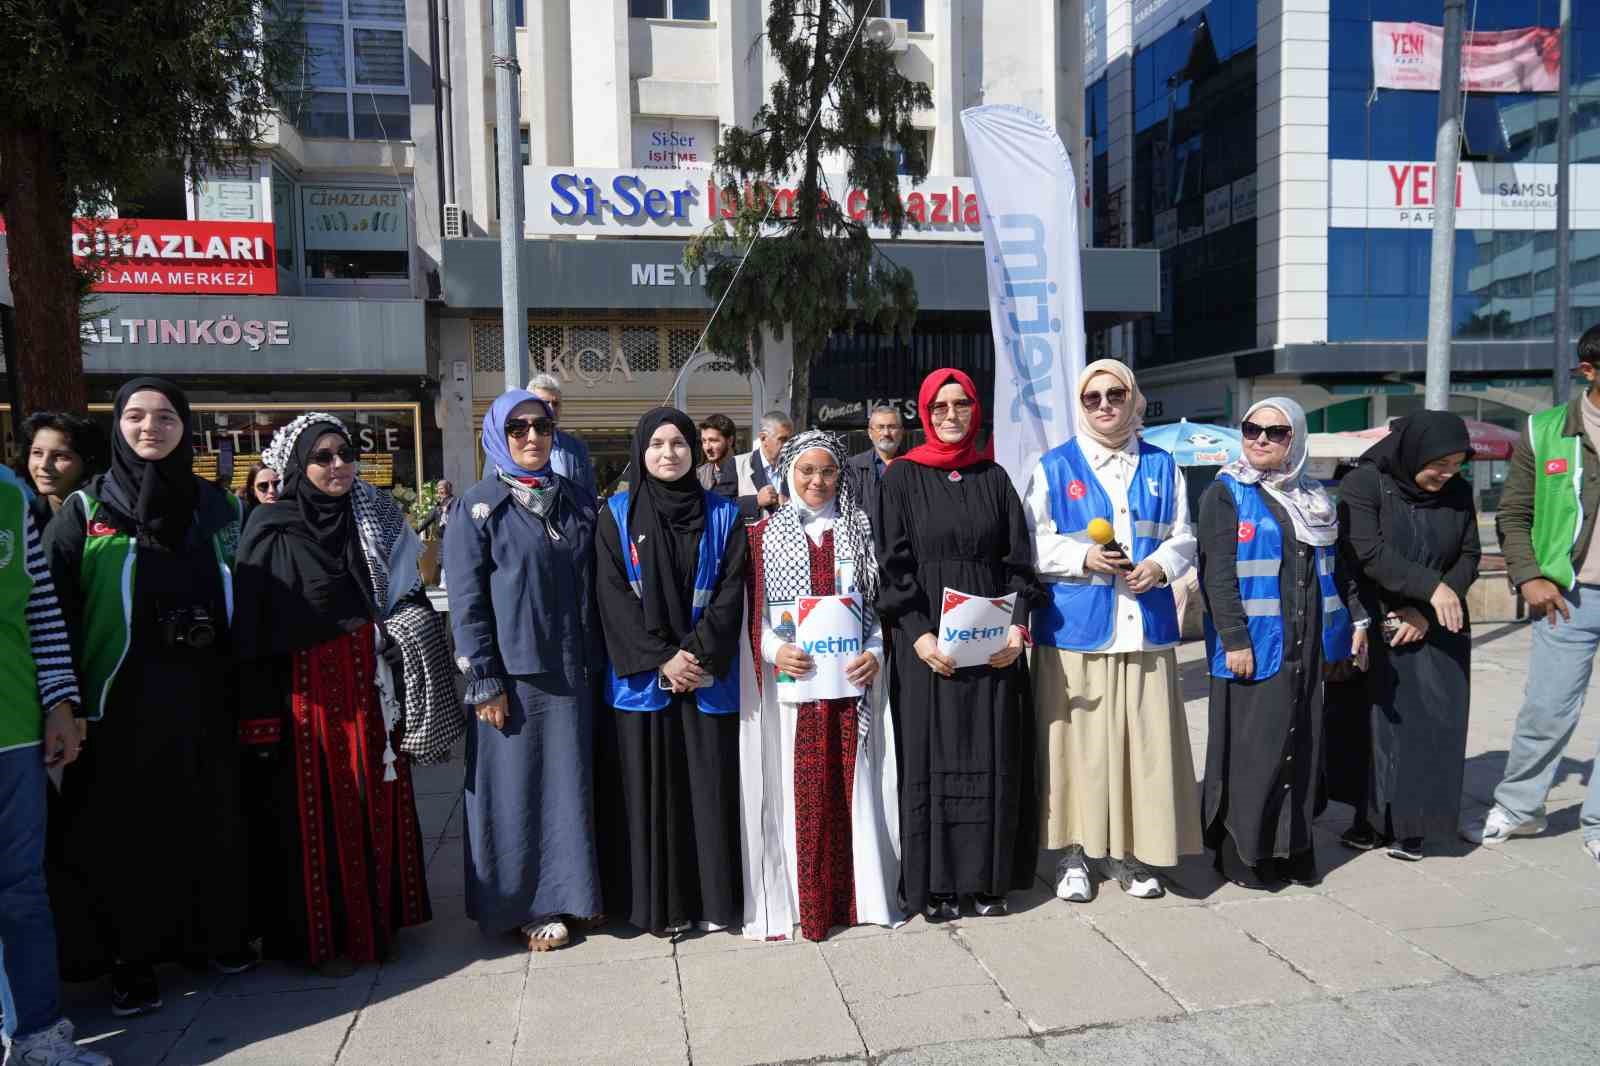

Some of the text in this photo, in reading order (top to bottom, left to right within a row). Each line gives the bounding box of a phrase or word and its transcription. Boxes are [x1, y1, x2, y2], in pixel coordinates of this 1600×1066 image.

[651, 130, 696, 148] Si-Ser
[550, 173, 692, 220] Si-Ser
[1388, 165, 1463, 209] YEİ
[1499, 183, 1558, 198] SAMSU
[72, 228, 265, 261] CİHAZLARI
[168, 271, 254, 286] MERKEZİ
[80, 312, 290, 352] ALTINKÖŞE
[943, 624, 1004, 643] yetim
[802, 634, 860, 655] yetim
